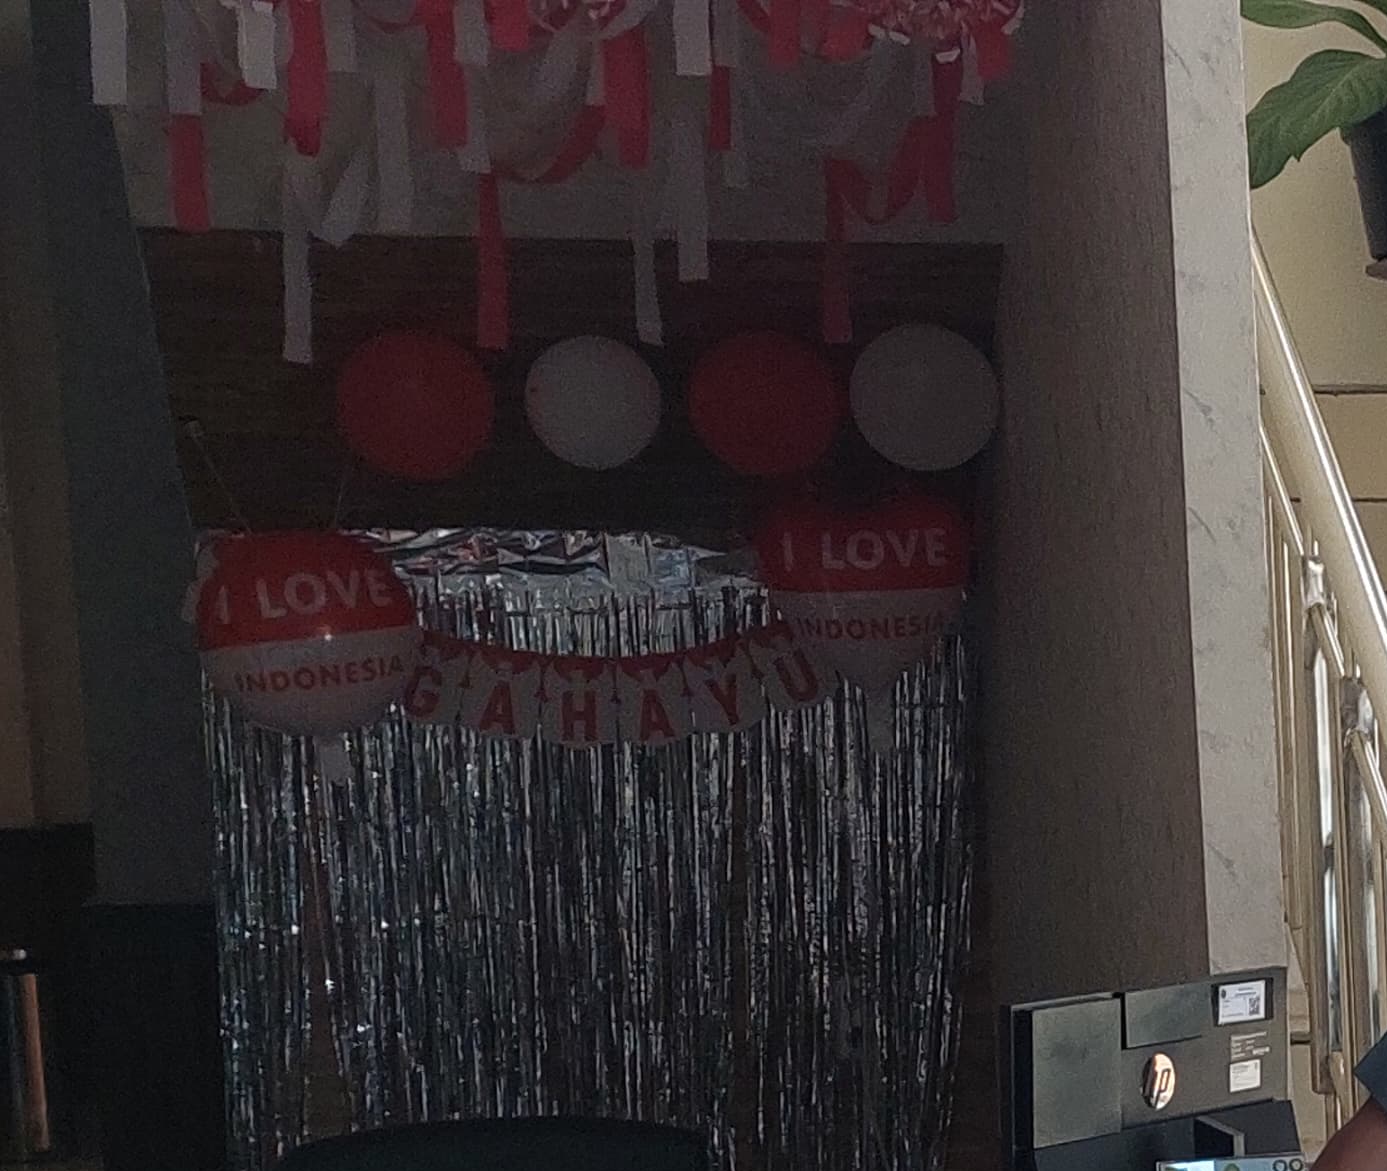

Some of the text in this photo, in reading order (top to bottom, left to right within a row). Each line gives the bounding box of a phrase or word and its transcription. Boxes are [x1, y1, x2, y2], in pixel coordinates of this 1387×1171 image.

[782, 527, 947, 572] I LOVE
[218, 566, 393, 624] I LOVE
[234, 655, 404, 693] INDONESIA
